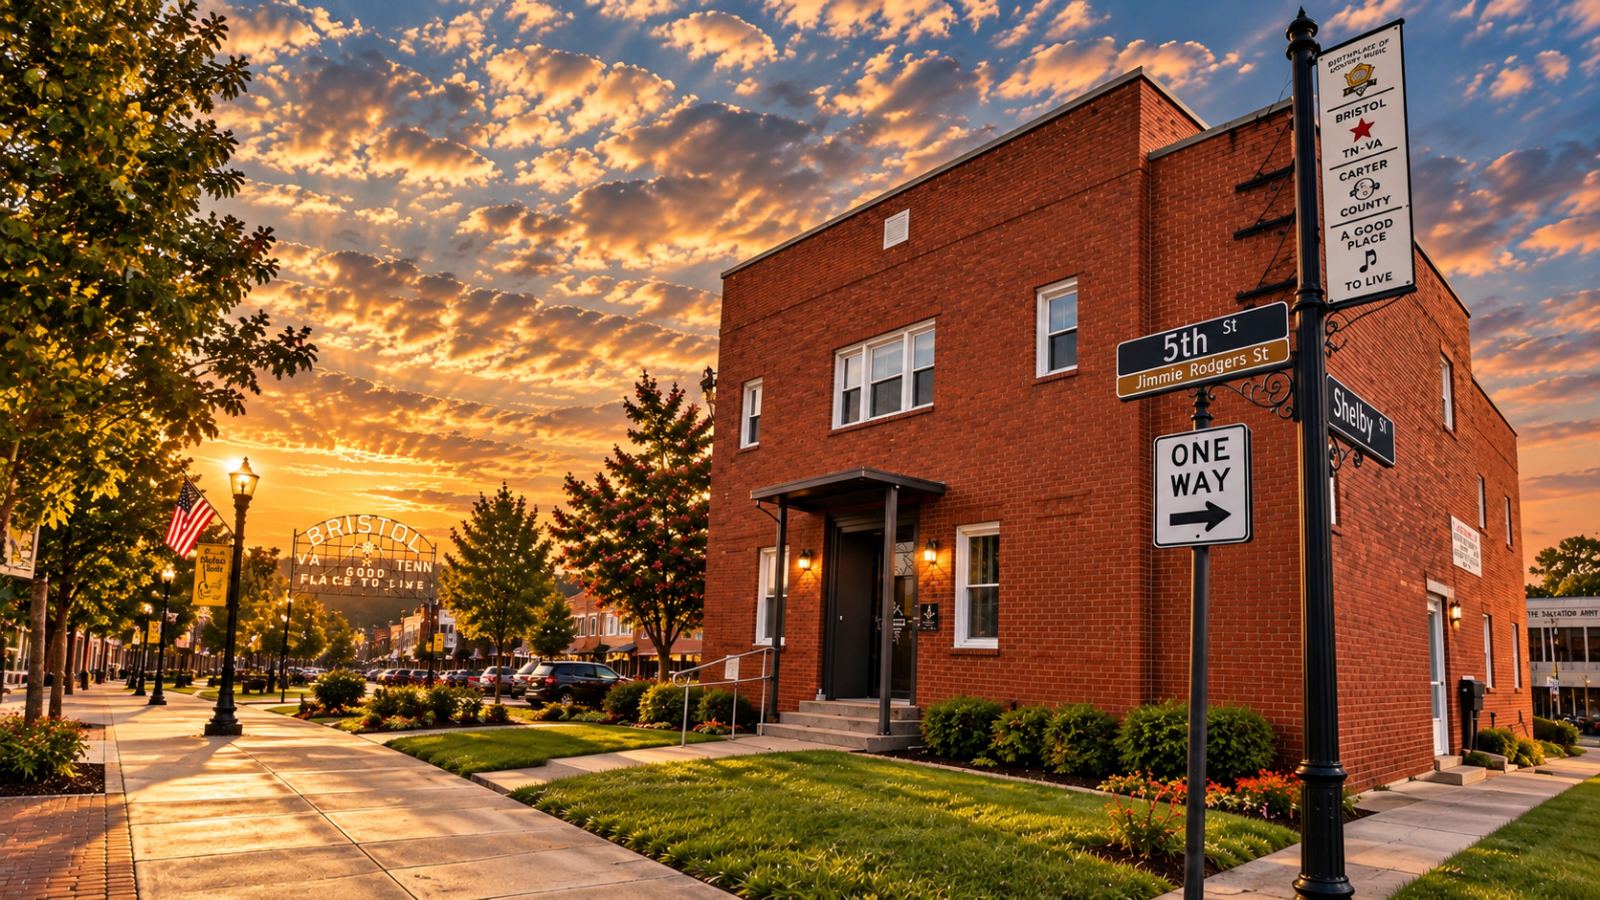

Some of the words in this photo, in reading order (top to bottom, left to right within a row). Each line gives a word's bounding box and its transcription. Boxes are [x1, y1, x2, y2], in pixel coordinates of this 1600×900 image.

[1335, 99, 1387, 123] BRISTOL
[1342, 138, 1382, 158] TN-VA
[1339, 159, 1388, 181] CARTER
[1340, 195, 1391, 217] COUNTY
[1340, 231, 1349, 241] A
[1354, 219, 1393, 236] GOOD
[1347, 232, 1386, 250] PLACE
[1345, 280, 1361, 291] TO
[1366, 272, 1392, 286] LIVE
[1163, 328, 1208, 362] 5th
[1222, 318, 1237, 335] St
[1136, 367, 1183, 389] Jimmie
[1190, 354, 1247, 374] Rodgers
[1253, 347, 1269, 362] St
[1334, 387, 1373, 443] Shelby
[1171, 437, 1230, 466] ONE
[1170, 467, 1231, 497] WAY
[306, 514, 420, 554] BRISTOL
[296, 553, 320, 566] VA
[396, 560, 432, 573] TENN
[345, 566, 385, 579] GOOD
[361, 578, 379, 588] TO
